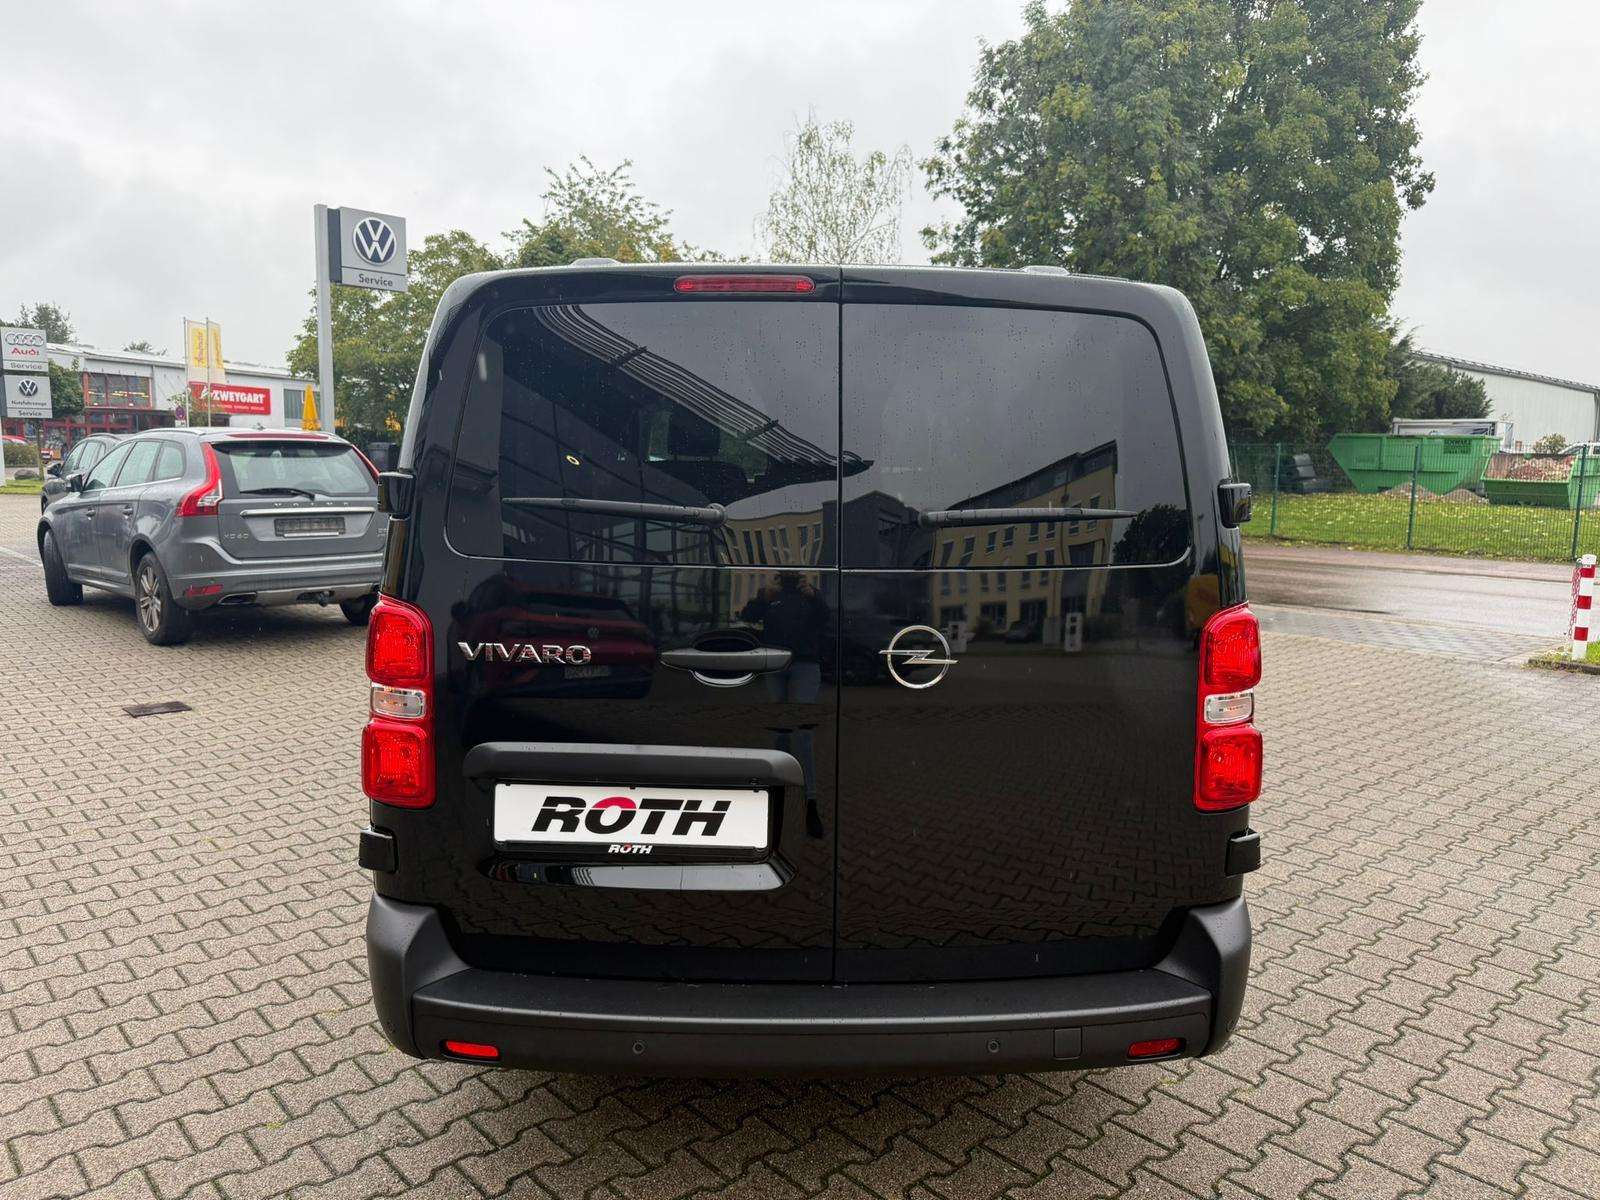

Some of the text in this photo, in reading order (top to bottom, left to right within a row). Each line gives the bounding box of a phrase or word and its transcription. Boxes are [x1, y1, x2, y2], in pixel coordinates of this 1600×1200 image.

[358, 273, 394, 287] Service
[11, 347, 40, 356] Audi
[10, 362, 43, 370] Service
[212, 389, 266, 404] ZWEYGART
[457, 641, 592, 665] VIVARO
[531, 796, 733, 837] ROTH
[607, 843, 653, 855] ROTH
